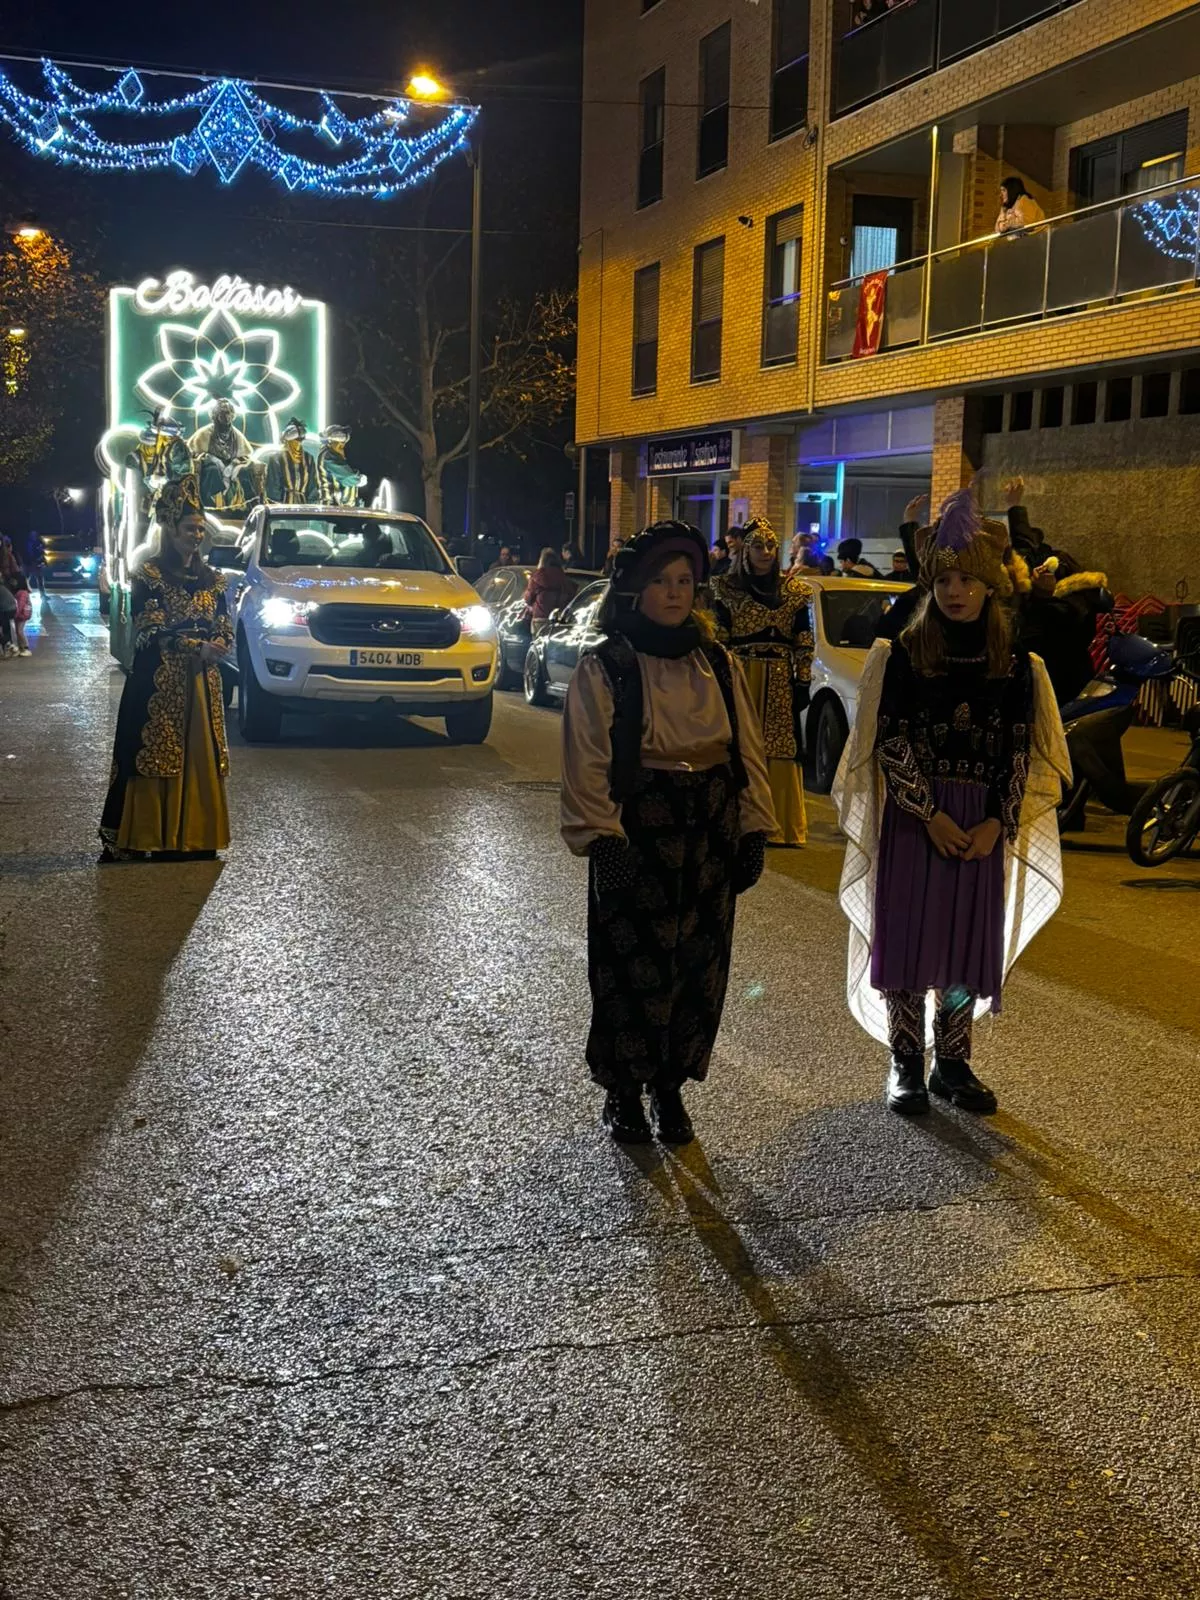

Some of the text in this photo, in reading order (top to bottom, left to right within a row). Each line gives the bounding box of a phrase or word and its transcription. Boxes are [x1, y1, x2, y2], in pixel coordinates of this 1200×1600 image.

[136, 270, 302, 312] Baltasar
[360, 653, 421, 665] 5404 MDB
